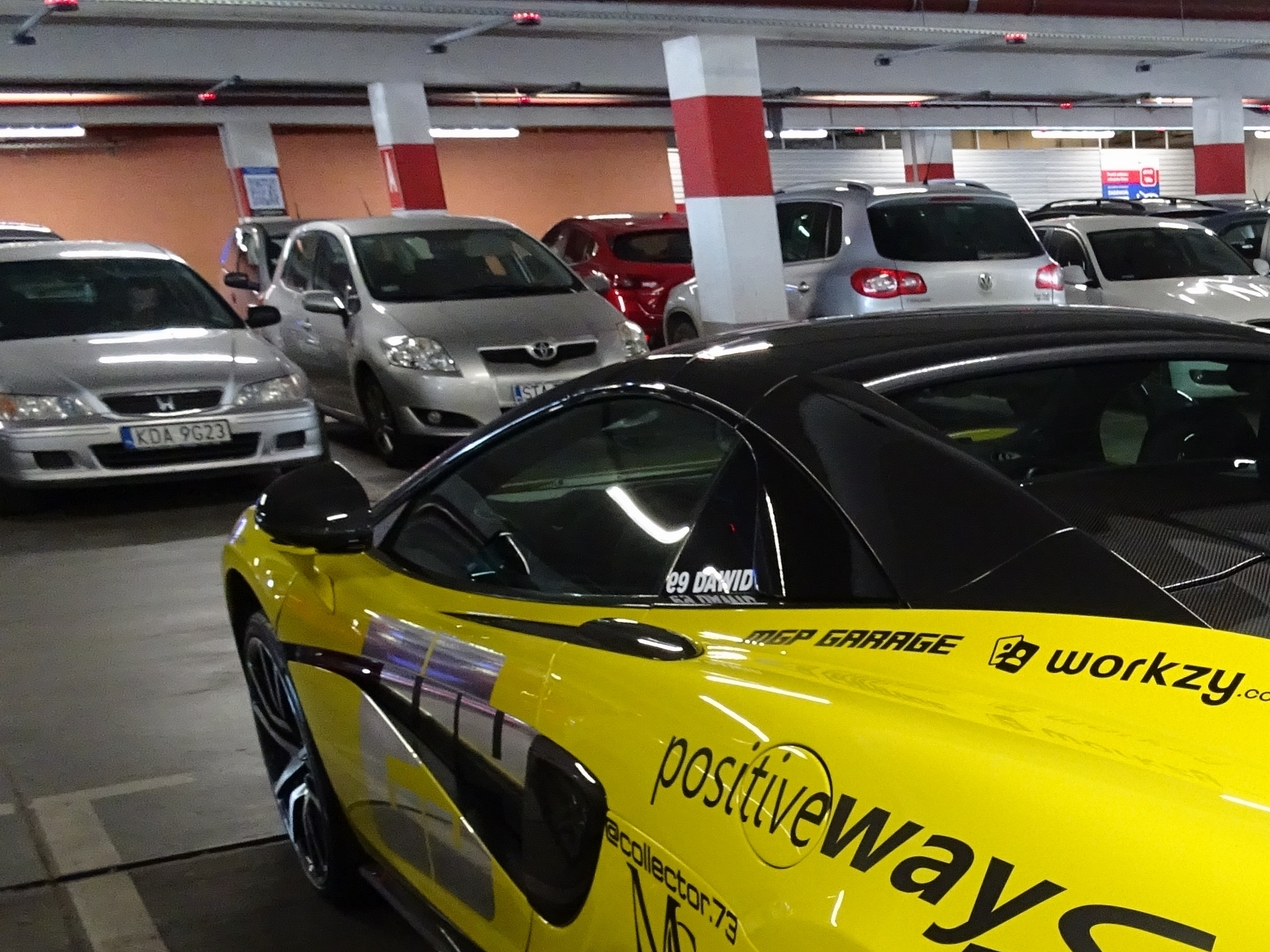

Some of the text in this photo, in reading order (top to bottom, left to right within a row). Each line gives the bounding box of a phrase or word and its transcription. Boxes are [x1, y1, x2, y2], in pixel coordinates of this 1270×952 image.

[135, 423, 226, 445] KDA 9G23
[692, 568, 754, 594] DAWID
[747, 629, 965, 656] MGP GARAGE
[606, 819, 738, 946] @collector.73
